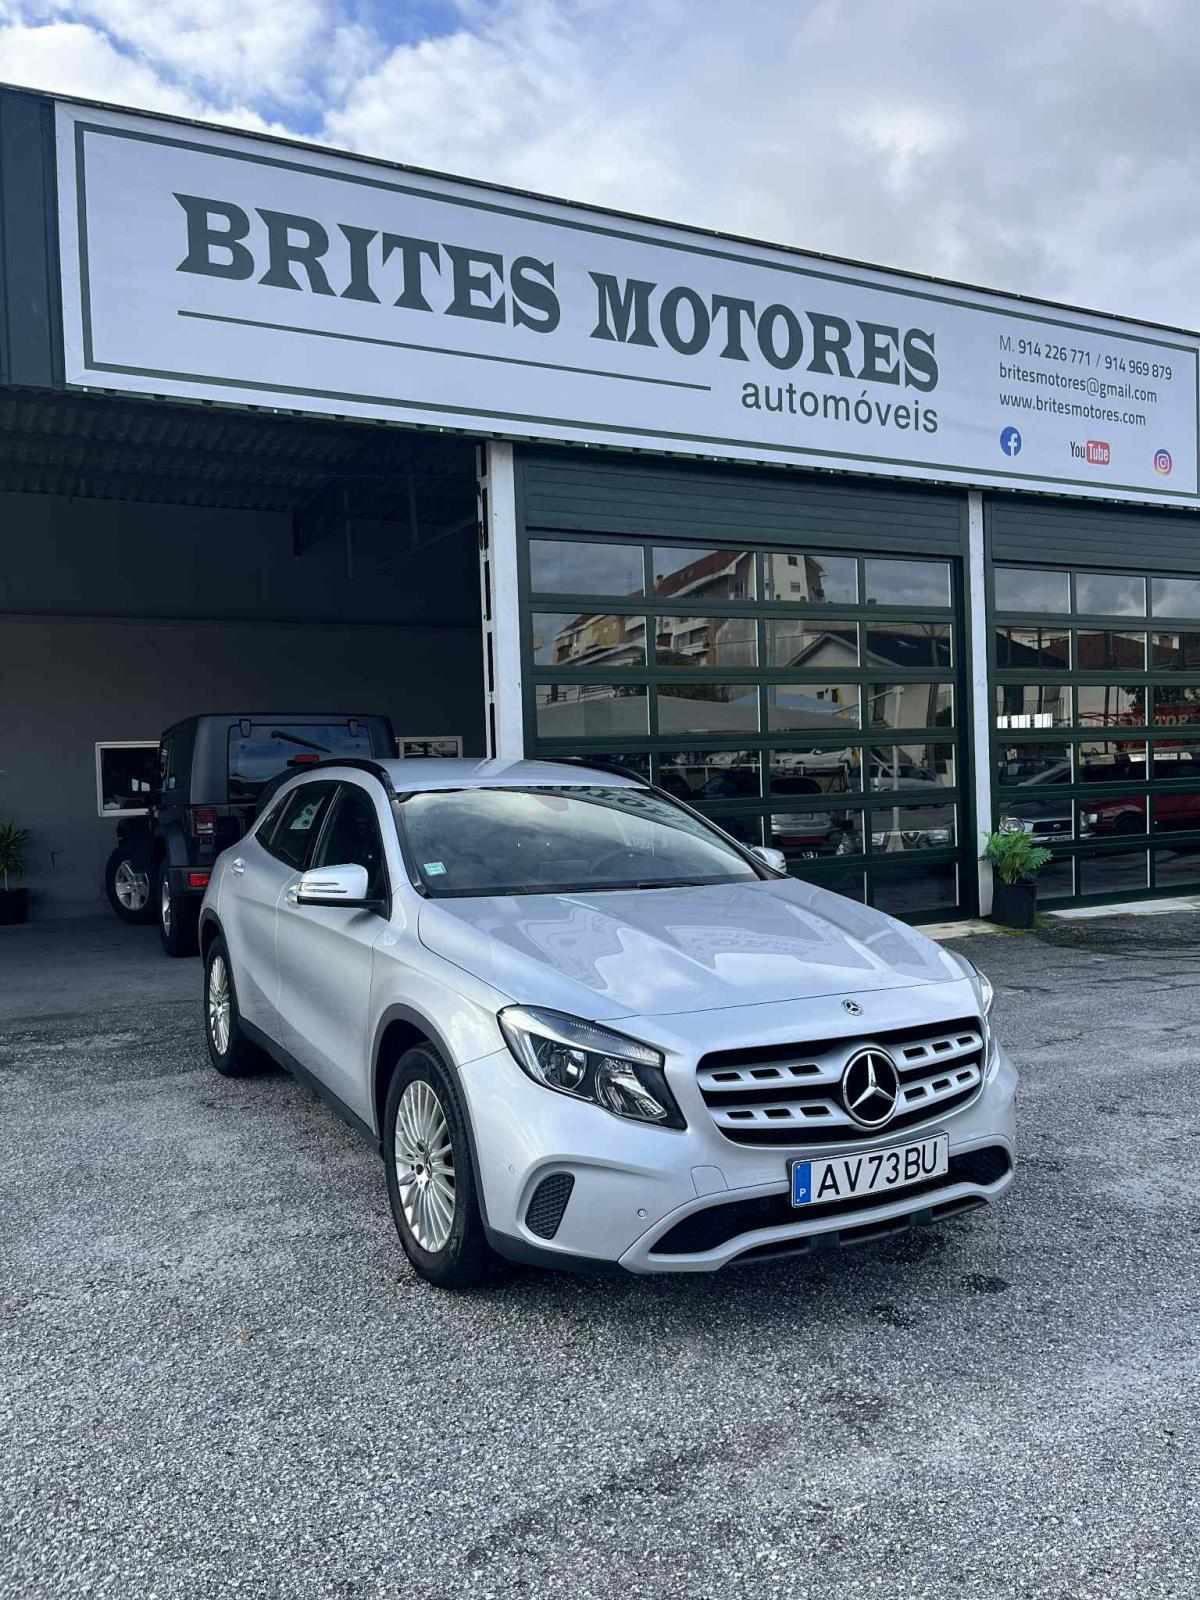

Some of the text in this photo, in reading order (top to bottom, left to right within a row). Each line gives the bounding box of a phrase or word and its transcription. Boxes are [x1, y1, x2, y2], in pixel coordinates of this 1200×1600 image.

[172, 192, 939, 393] BRITES MOTORES
[1000, 335, 1016, 352] M.
[1018, 339, 1041, 357] 914
[1045, 344, 1067, 361] 226
[1070, 348, 1091, 366] 771
[1105, 355, 1126, 373] 914
[1129, 360, 1149, 376] 969
[1152, 364, 1172, 381] 879
[1000, 362, 1157, 403] britesmotores@gmail.com
[742, 381, 938, 433] automóveis
[1000, 392, 1146, 426] www.britesmotores.com
[799, 1188, 807, 1198] P
